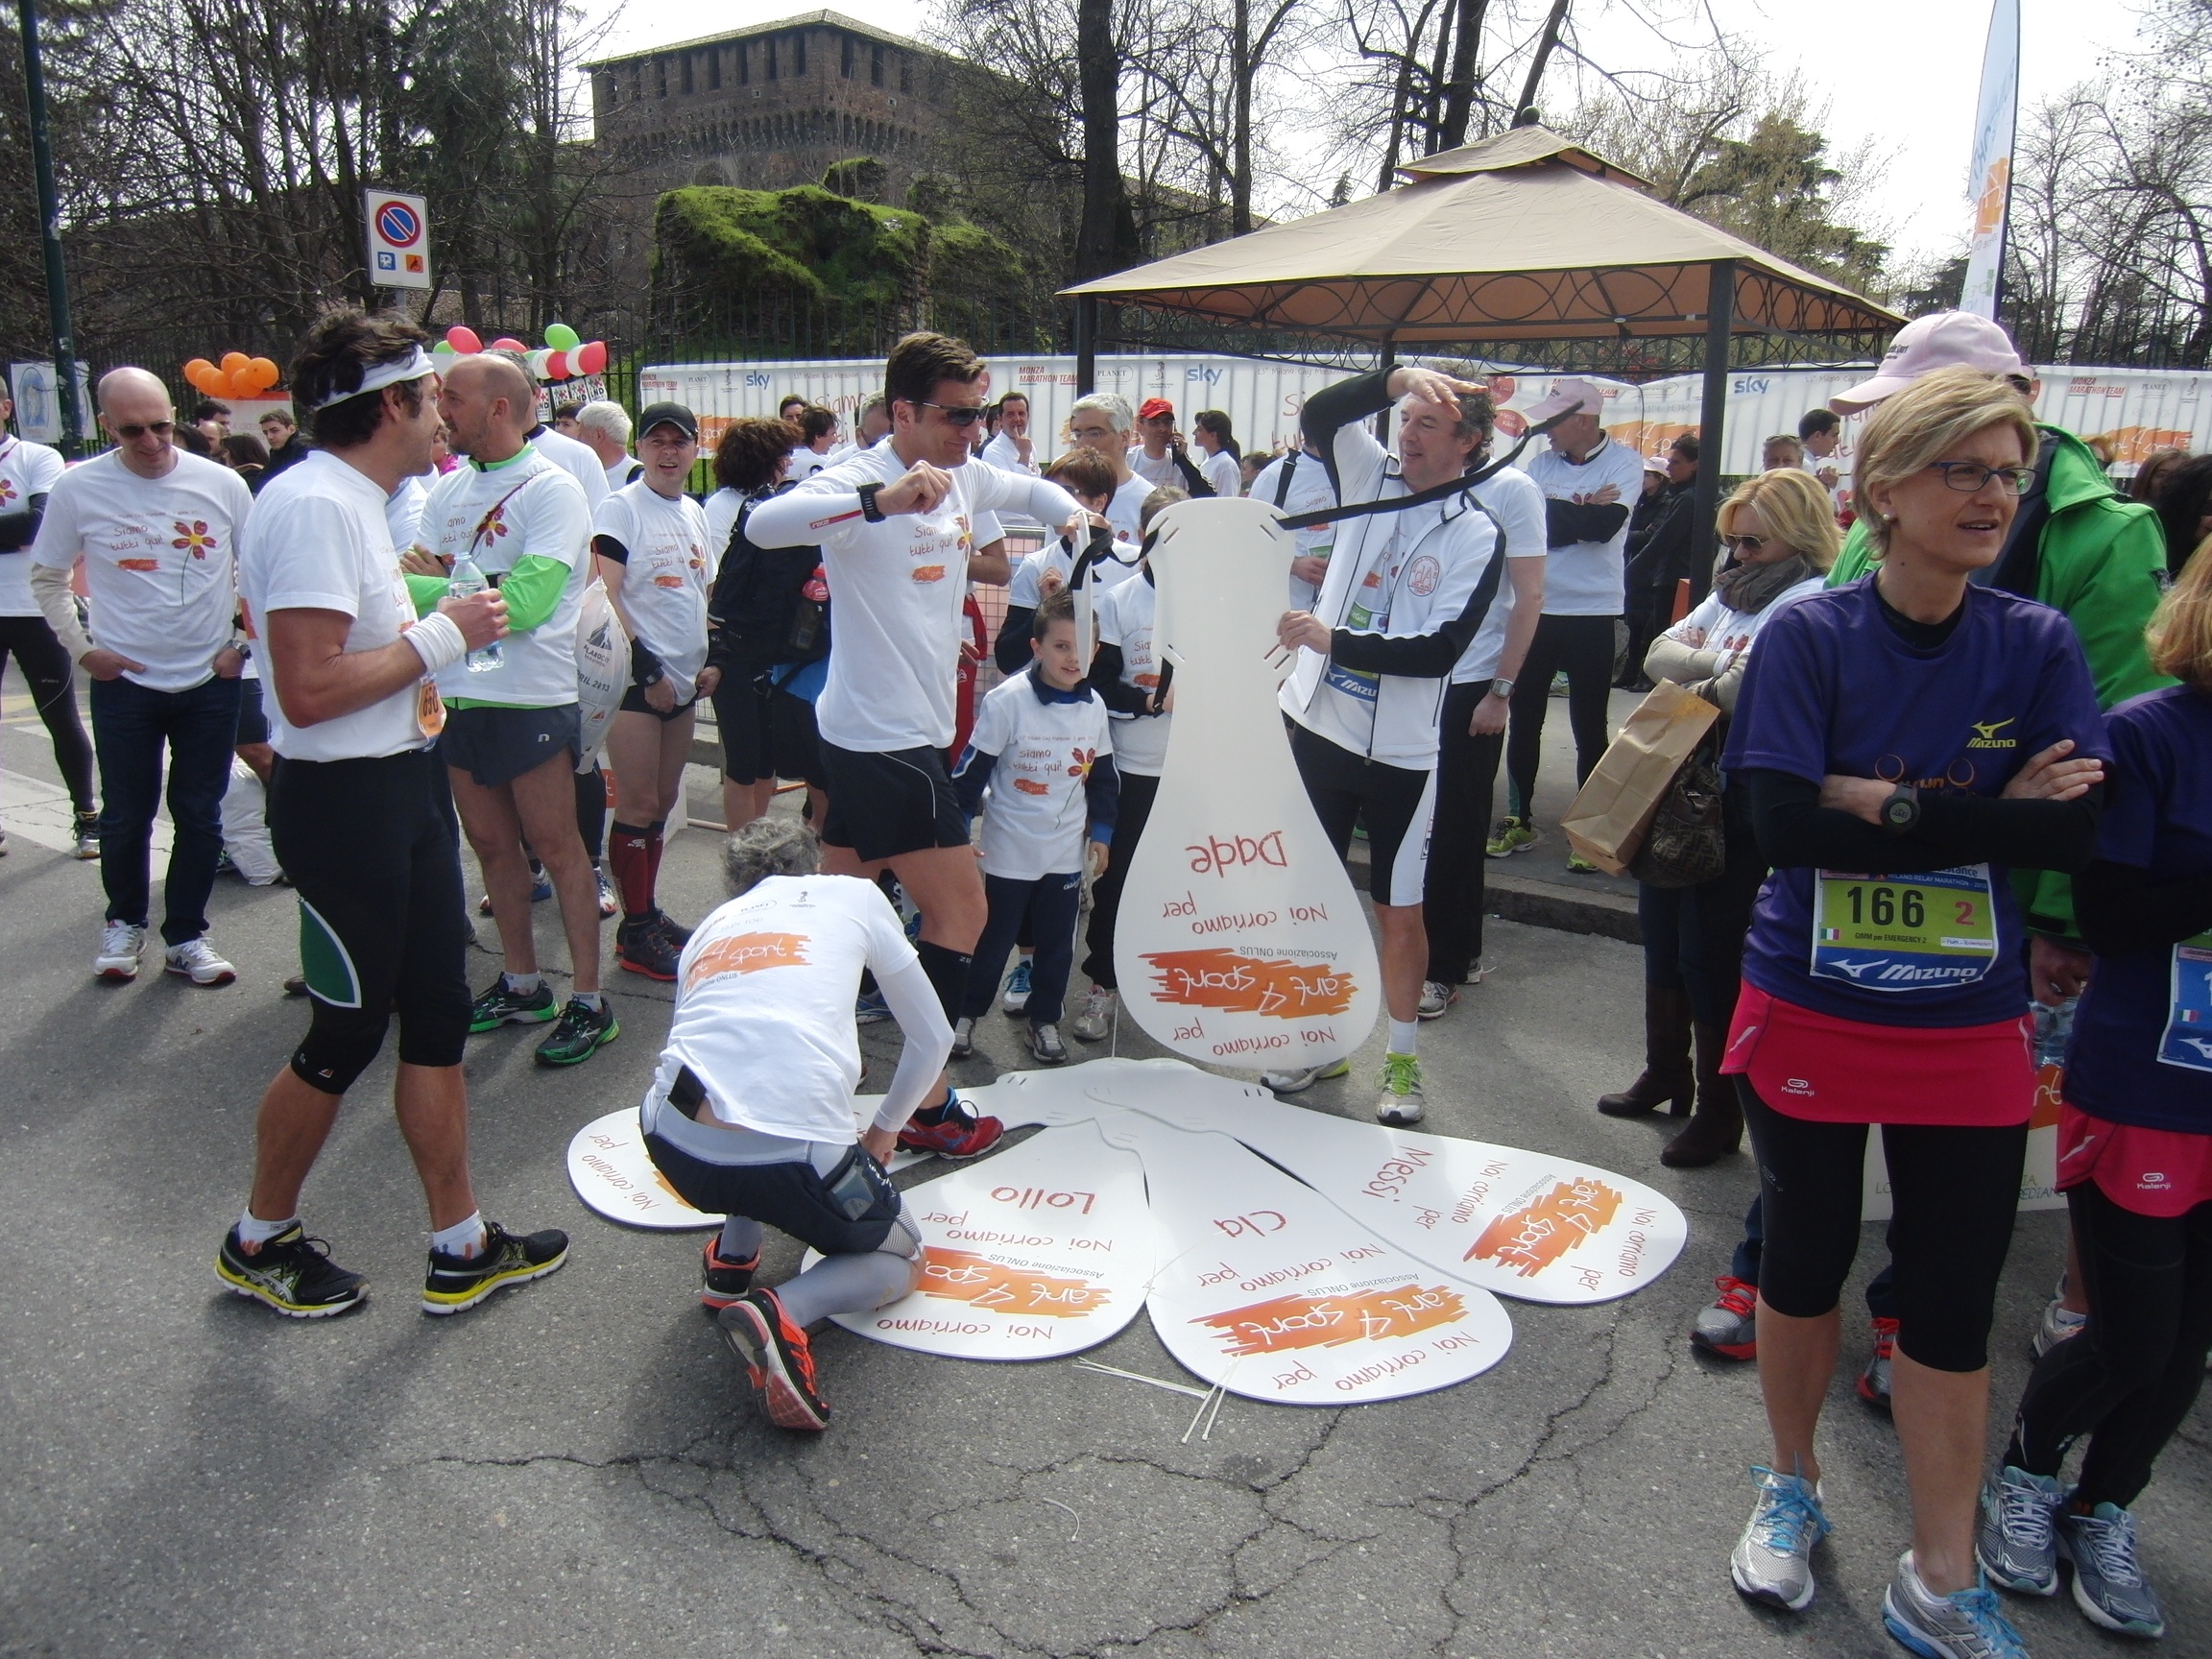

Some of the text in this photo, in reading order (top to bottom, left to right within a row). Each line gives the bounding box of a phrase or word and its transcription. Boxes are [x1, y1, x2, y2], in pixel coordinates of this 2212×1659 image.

[746, 371, 770, 389] sky
[1019, 366, 1045, 374] MONZA
[1187, 363, 1222, 386] sky
[1734, 375, 1770, 394] sky
[2068, 386, 2105, 395] MARATHON
[1306, 495, 1327, 508] Siamo
[114, 525, 148, 537] Siamo
[110, 536, 163, 551] tutti qui!
[655, 543, 679, 556] Siamo
[909, 540, 934, 557] tutti
[652, 557, 673, 568] tutti
[1966, 737, 2016, 749] MIZUNO
[1013, 760, 1062, 776] tutti qui!
[1914, 874, 1934, 882] RELAY
[1935, 877, 1969, 886] MARATHON
[1163, 891, 1328, 934] Noi corriamo per
[1847, 886, 1925, 927] 166
[1955, 901, 1975, 926] 2
[1884, 934, 1921, 944] EMERGENCY
[729, 938, 787, 967] sport
[1239, 946, 1338, 960] Associazione ONLUS
[716, 973, 737, 983] ONLUS
[1877, 964, 1979, 981] MIZUNO
[1173, 966, 1338, 1012] art 4 sport
[1173, 1017, 1336, 1055] Noi corriamo per
[1781, 1086, 1815, 1096] Kalenji
[589, 1134, 629, 1151] per
[582, 1154, 661, 1212] Noi corriamo
[1361, 1145, 1434, 1202] Messi
[991, 1186, 1095, 1215] Lollo
[1412, 1159, 1509, 1230] Noi corriamo per
[921, 1211, 1113, 1252] Noi corriamo per
[1497, 1184, 1599, 1260] art 4 sport
[1570, 1207, 1658, 1292] Noi corriamo per
[987, 1253, 1105, 1279] Associazione ONLUS
[1197, 1242, 1386, 1292] Noi corriamo per
[970, 1283, 1016, 1304] 4
[1028, 1283, 1090, 1307] art
[1307, 1273, 1420, 1297] Associazione ONLUS
[1240, 1291, 1445, 1345] art 4 sport
[877, 1319, 1052, 1339] Noi corriamo
[1271, 1330, 1480, 1391] Noi corriamo per
